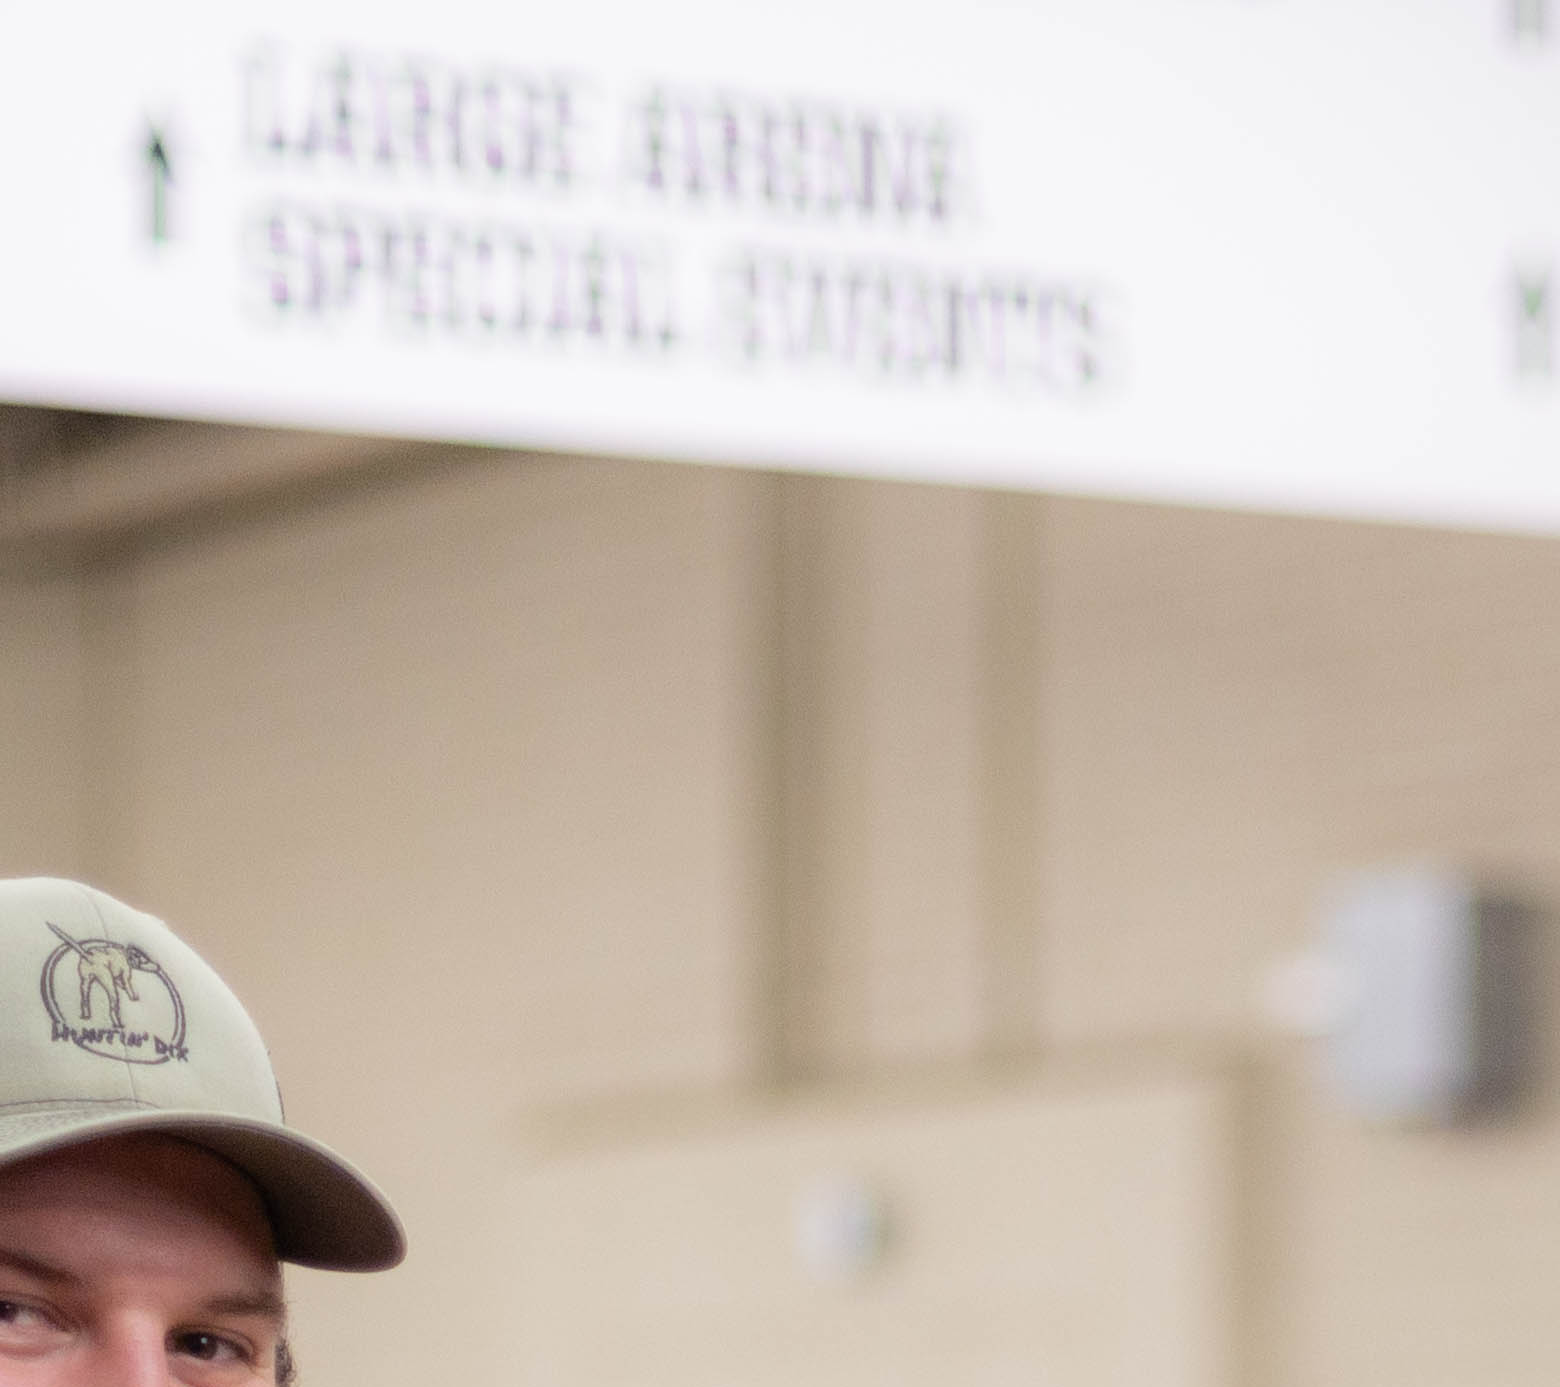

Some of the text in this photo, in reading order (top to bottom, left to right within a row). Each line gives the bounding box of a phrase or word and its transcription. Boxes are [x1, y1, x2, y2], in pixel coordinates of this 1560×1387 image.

[243, 42, 972, 222] LARGE ARENA
[246, 215, 1120, 393] SPECIAL EVENTS
